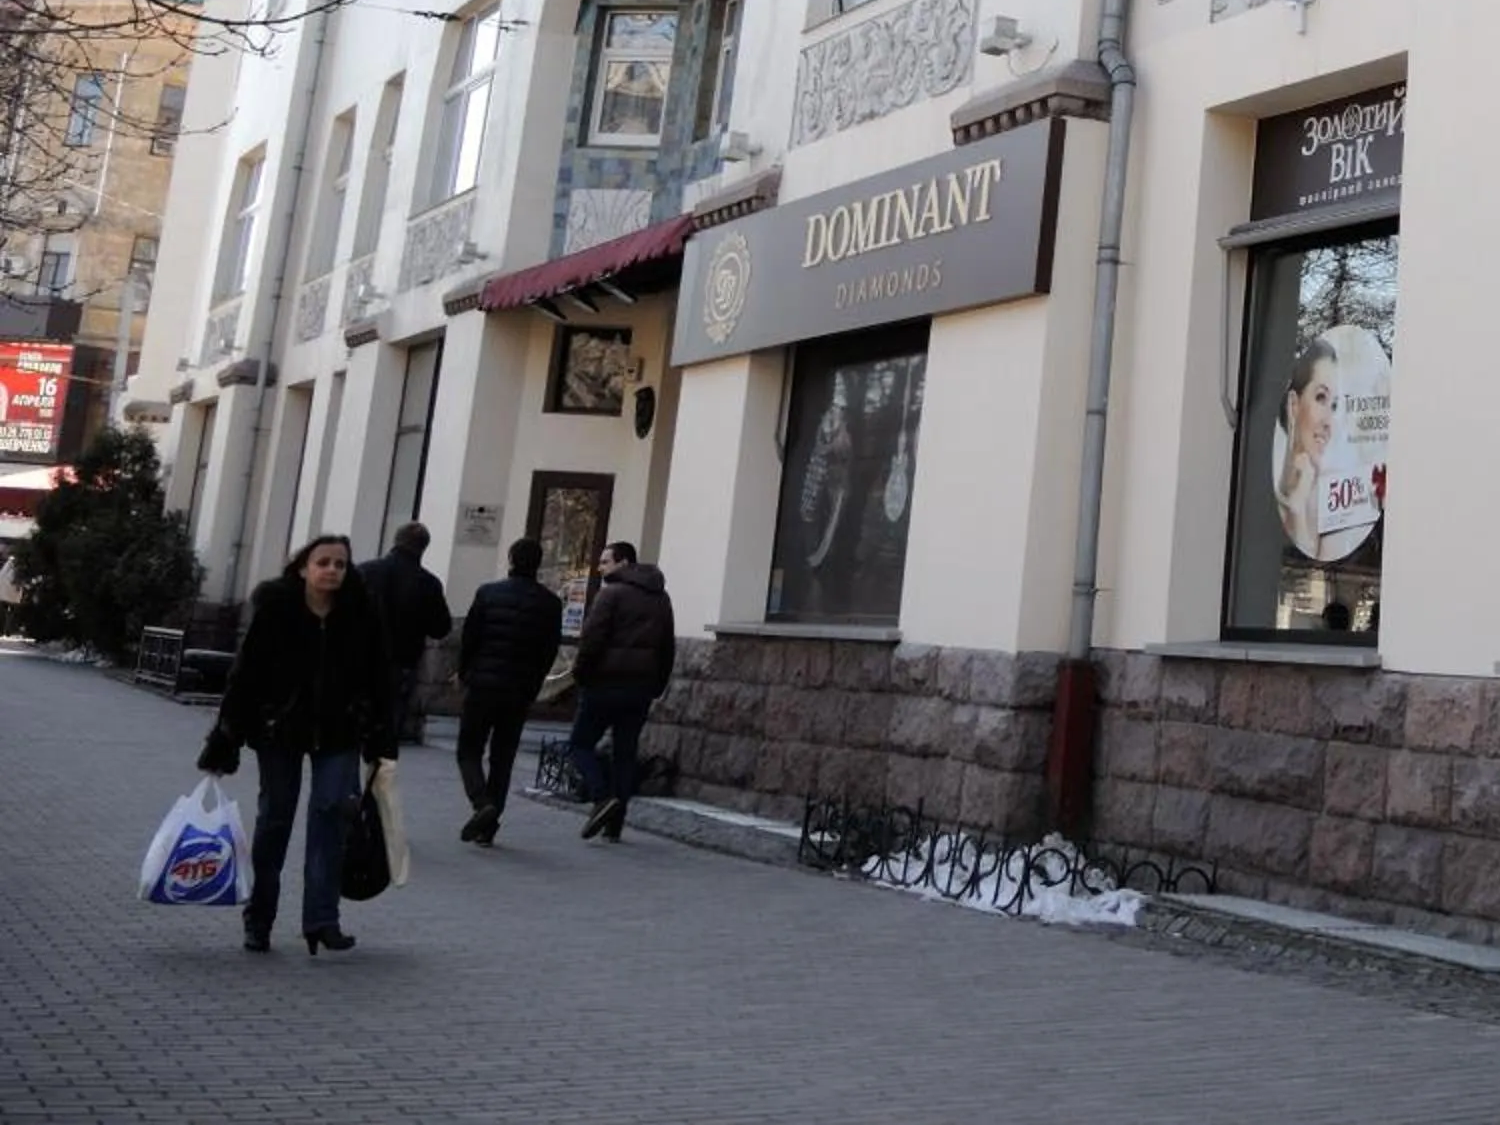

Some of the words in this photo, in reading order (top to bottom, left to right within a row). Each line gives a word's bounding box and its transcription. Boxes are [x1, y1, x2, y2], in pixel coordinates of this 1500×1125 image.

[1329, 134, 1374, 183] ВІК
[802, 158, 1002, 269] DOMINANT
[835, 261, 942, 309] DIAMONDS
[38, 377, 57, 396] 16
